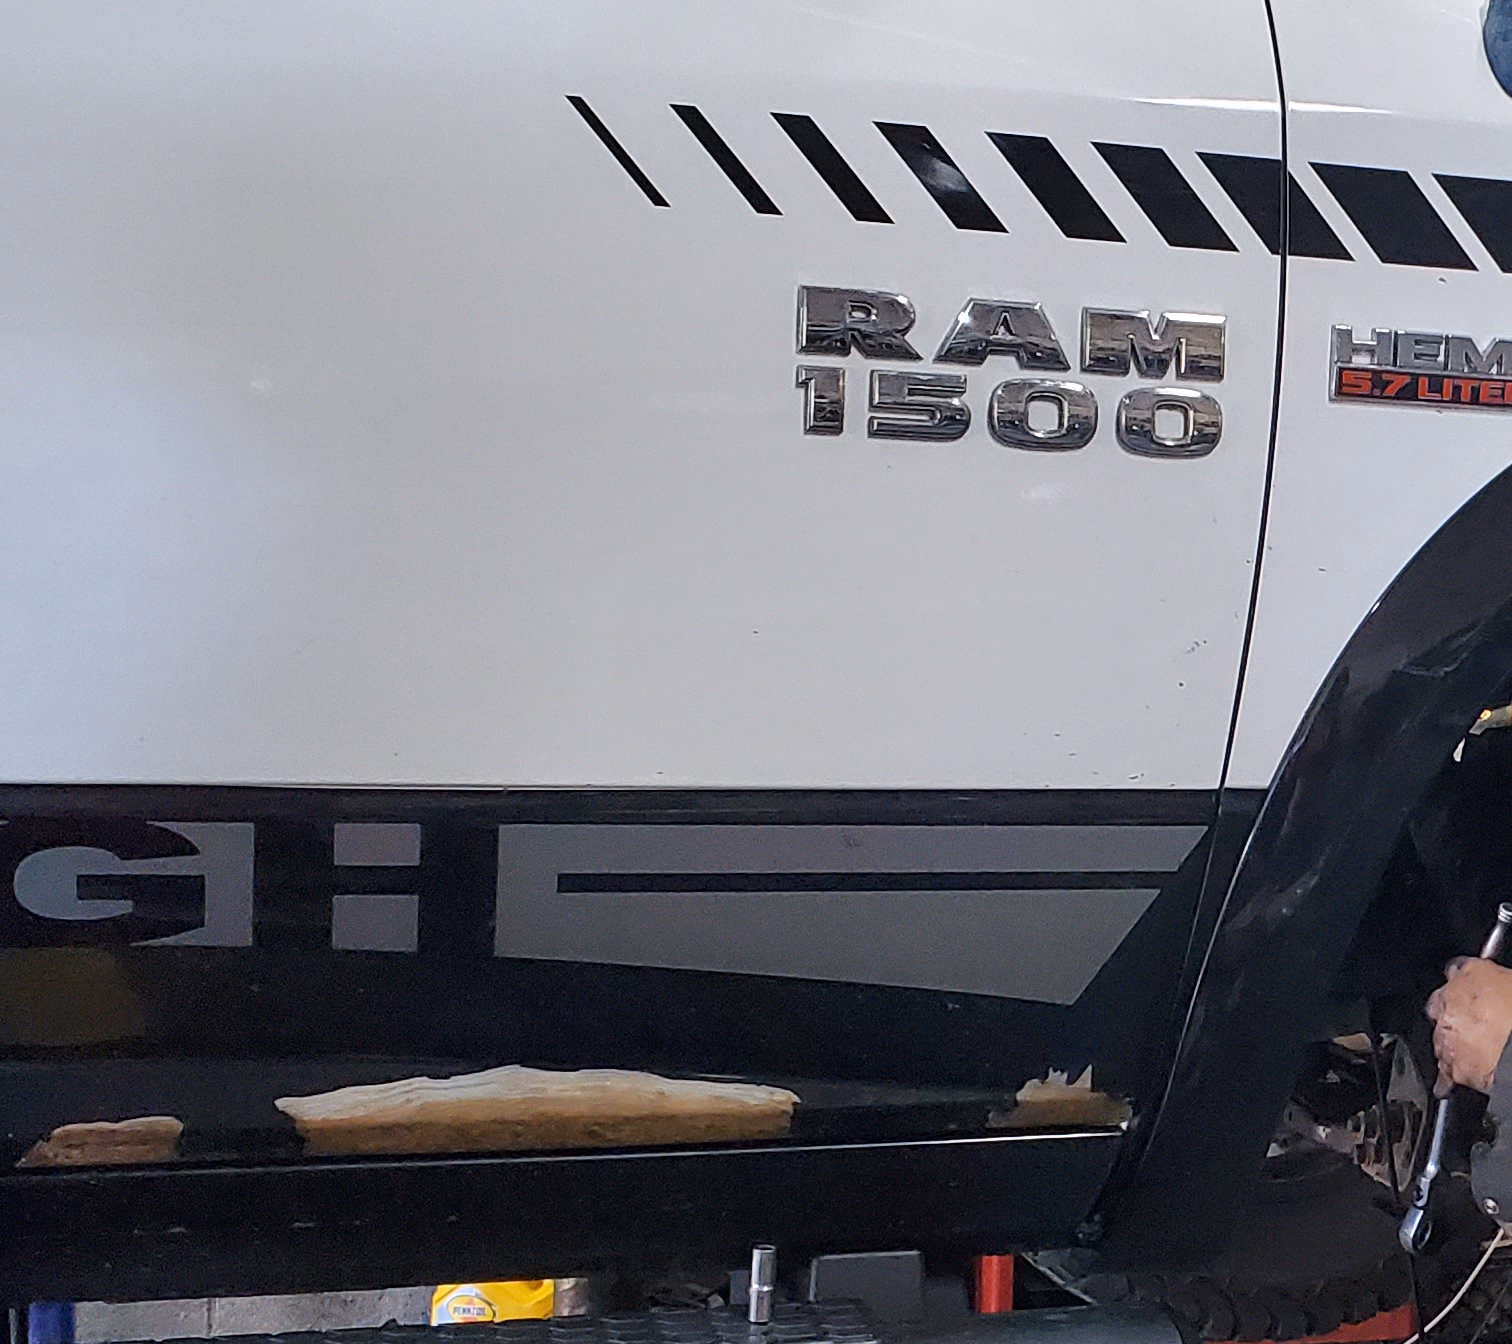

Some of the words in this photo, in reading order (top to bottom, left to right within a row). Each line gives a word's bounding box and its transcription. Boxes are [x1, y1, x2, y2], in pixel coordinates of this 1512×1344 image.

[795, 284, 1228, 381] RAM
[795, 365, 1224, 459] 1500
[1340, 370, 1406, 399] 5.7
